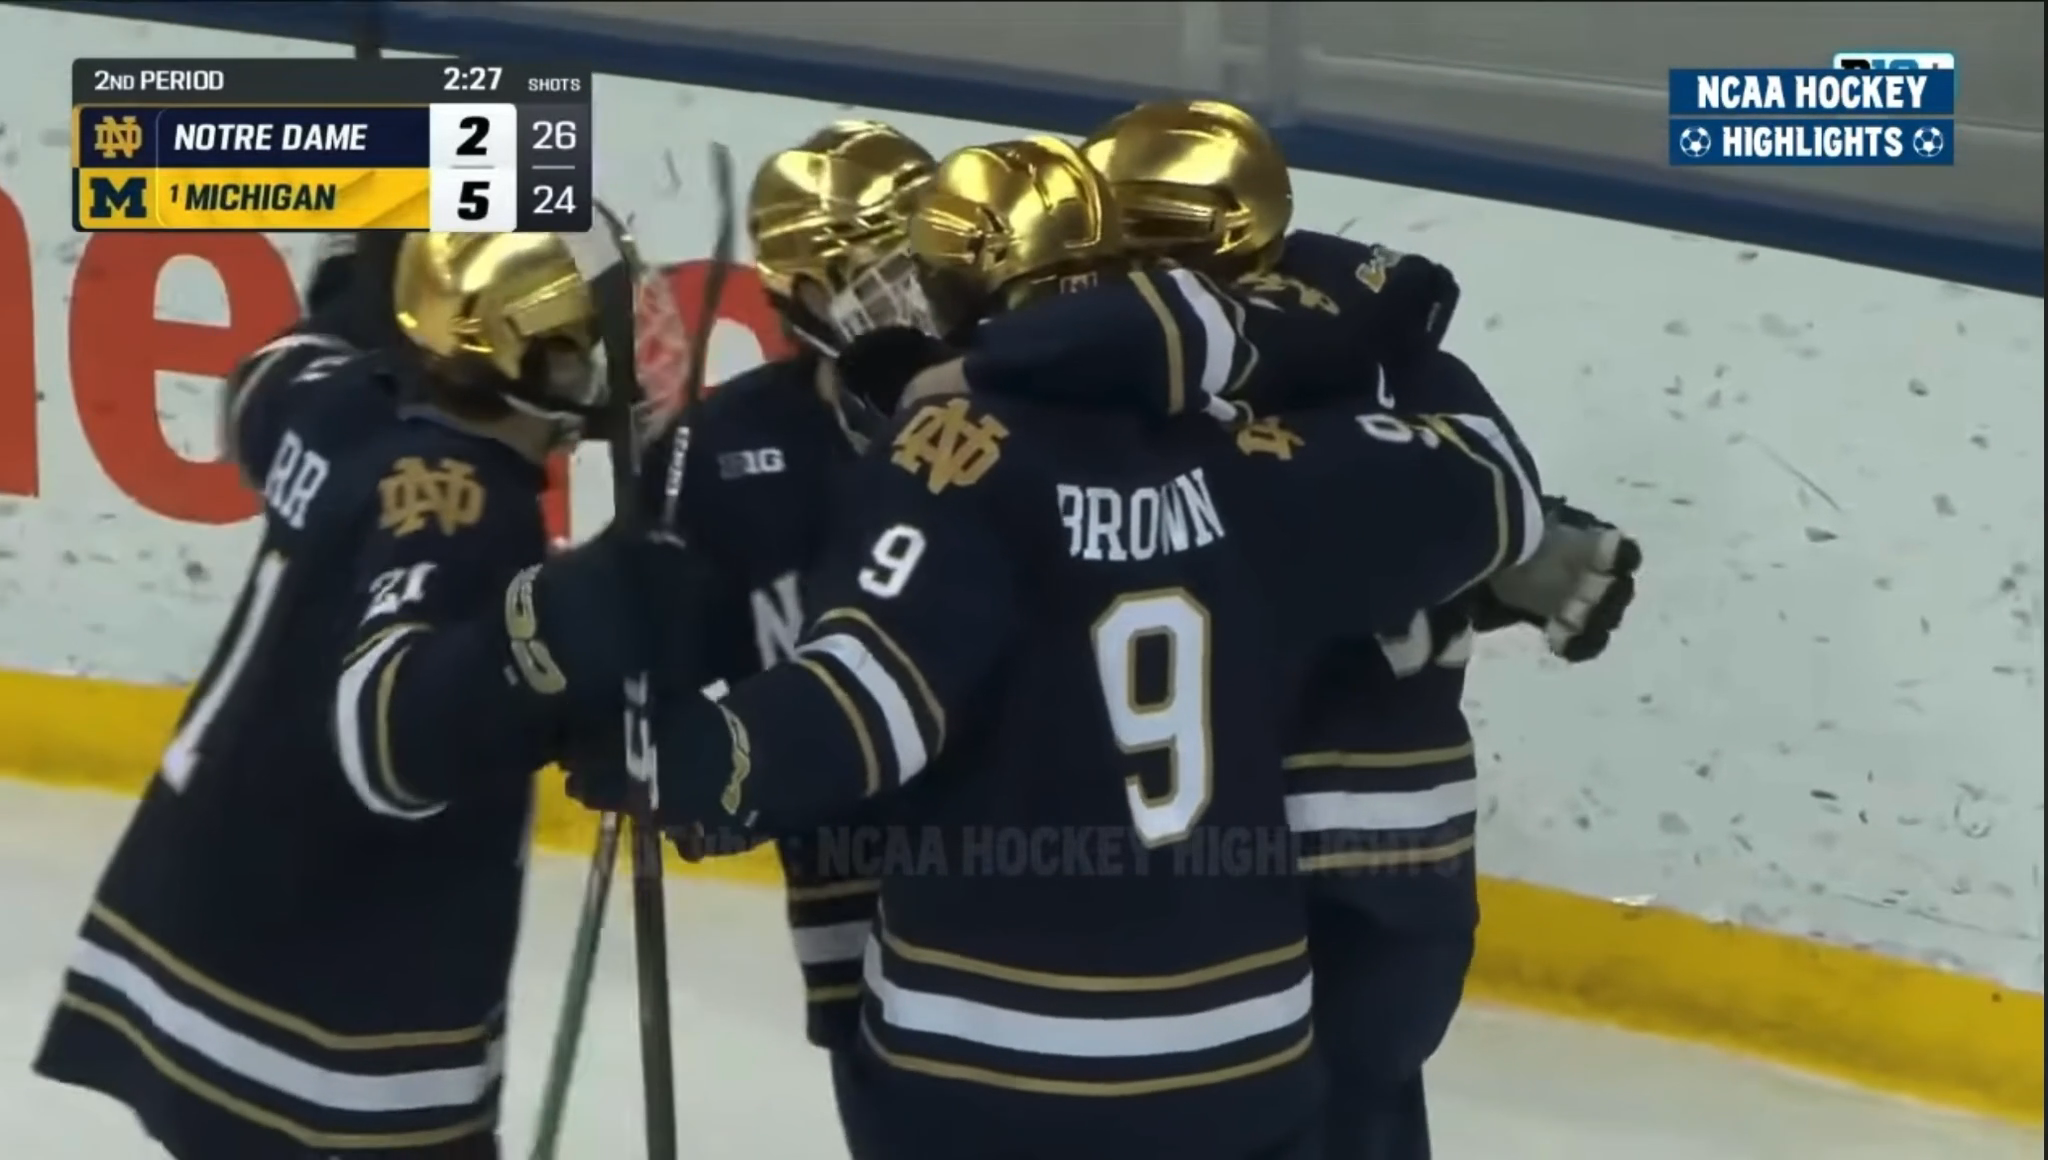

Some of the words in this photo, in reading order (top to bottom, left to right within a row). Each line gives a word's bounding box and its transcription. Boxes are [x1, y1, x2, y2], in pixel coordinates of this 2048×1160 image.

[858, 523, 927, 598] 9
[1056, 466, 1226, 562] BROWN
[1089, 586, 1214, 849] 9
